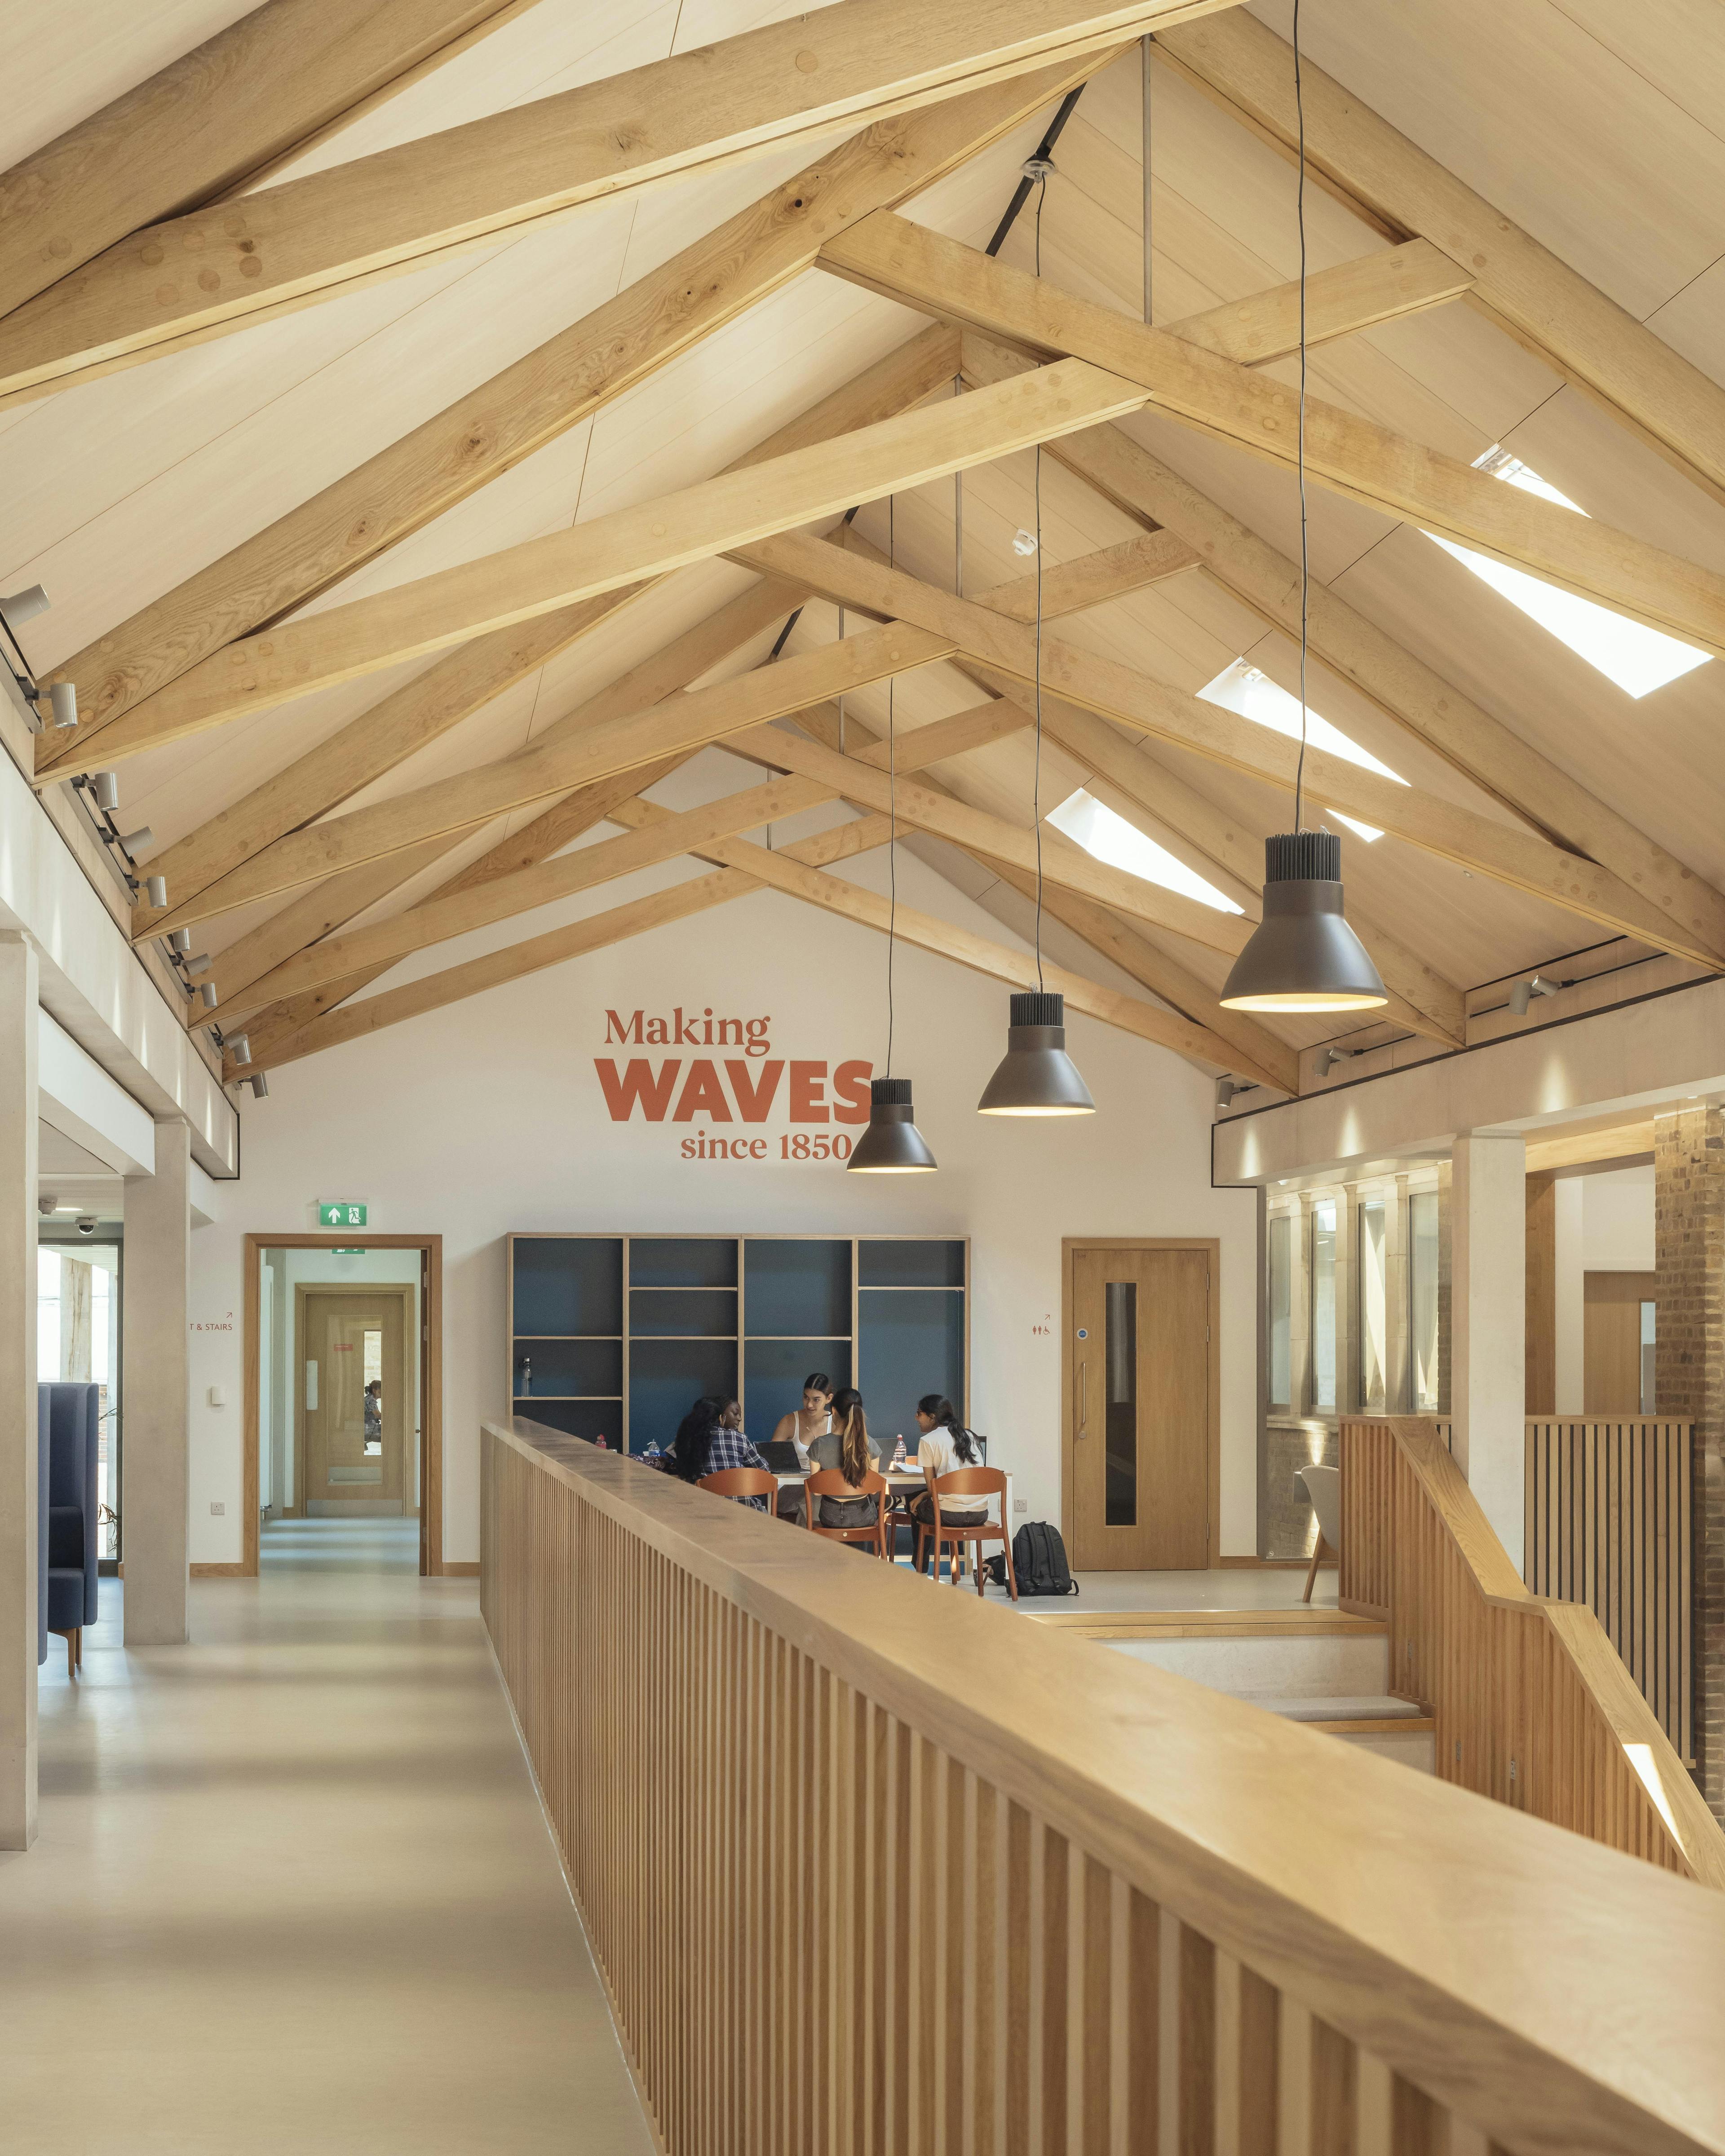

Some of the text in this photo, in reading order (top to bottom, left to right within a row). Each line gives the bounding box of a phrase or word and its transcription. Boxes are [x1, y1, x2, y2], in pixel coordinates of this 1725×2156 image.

[604, 1007, 771, 1057] Making
[594, 1058, 873, 1124] WAVES
[681, 1130, 852, 1160] since 1850
